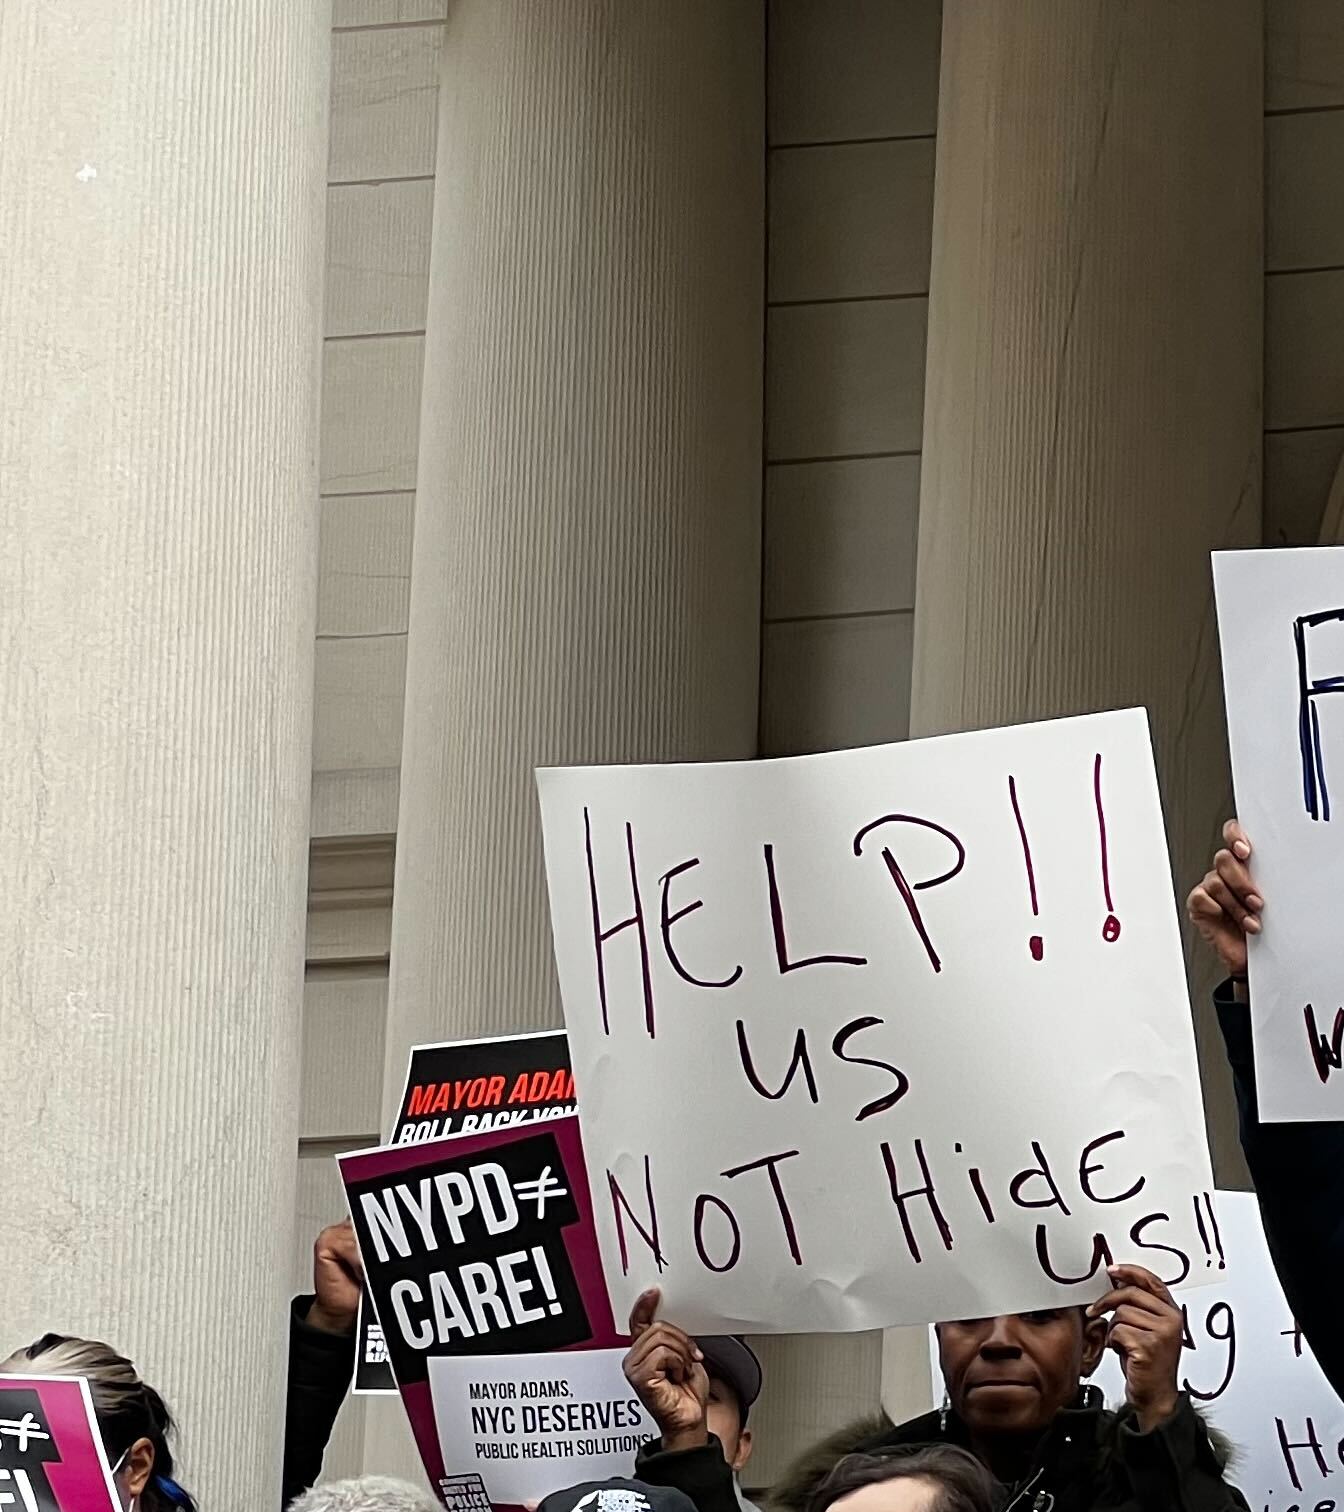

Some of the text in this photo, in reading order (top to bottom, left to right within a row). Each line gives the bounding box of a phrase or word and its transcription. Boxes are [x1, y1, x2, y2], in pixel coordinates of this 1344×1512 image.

[584, 753, 1121, 1038] HELP!!
[408, 1074, 506, 1116] MAYOR
[607, 1151, 803, 1276] NOT
[390, 1246, 564, 1349] CARE!
[469, 1379, 574, 1400] MAYOR ADAMS,
[471, 1399, 642, 1434] NYC DESERVES
[476, 1441, 519, 1459] PUBLIC
[523, 1439, 574, 1458] HEALTH
